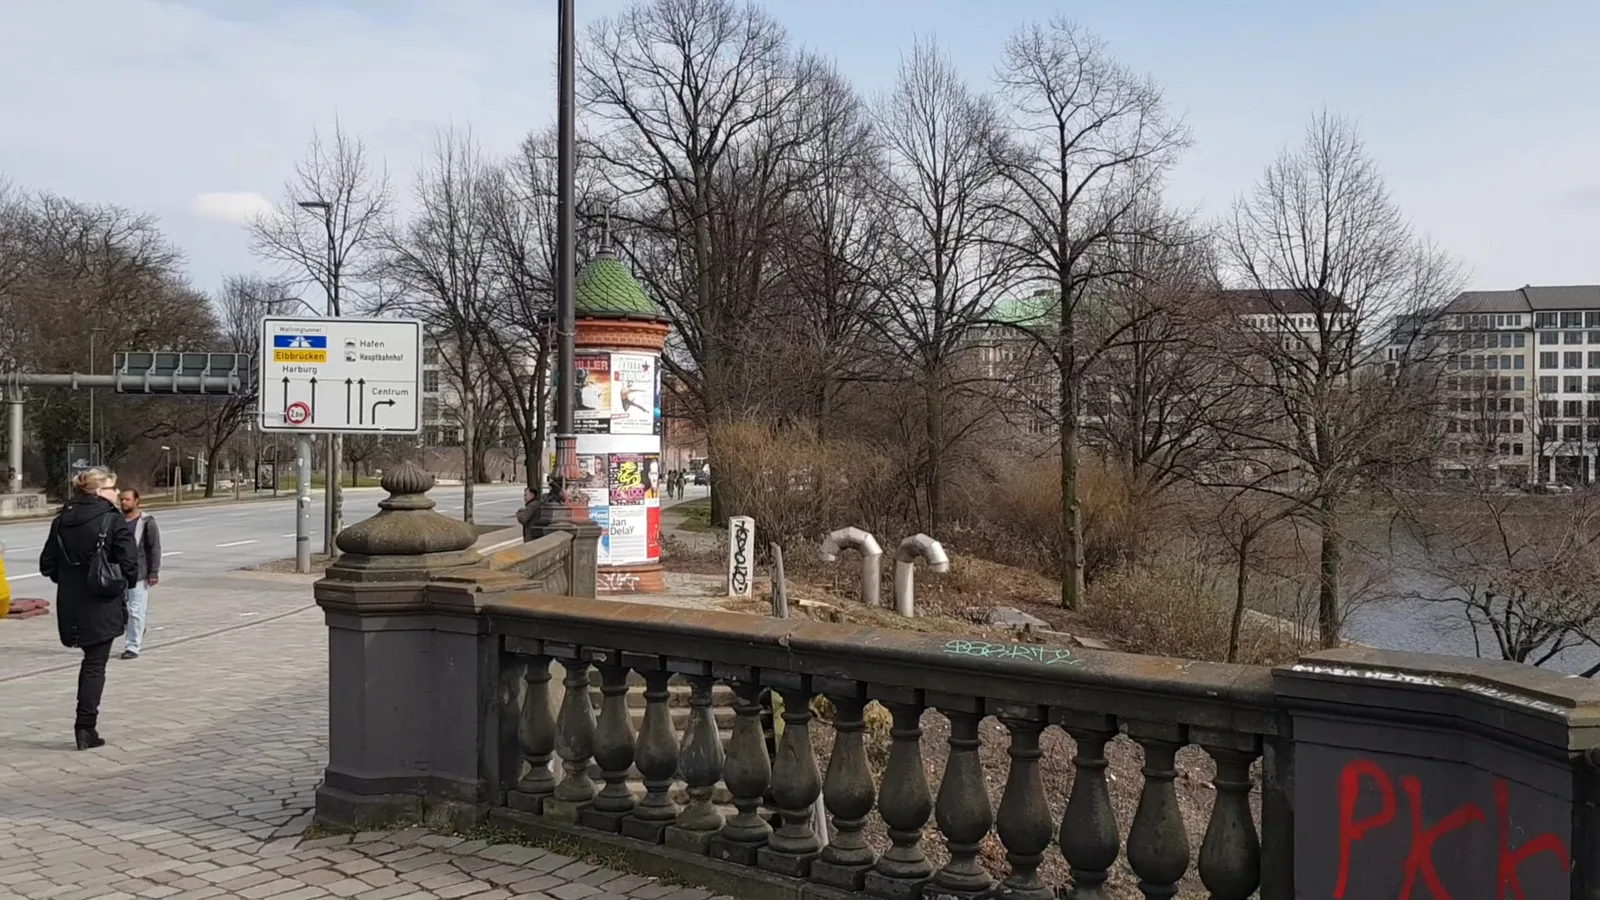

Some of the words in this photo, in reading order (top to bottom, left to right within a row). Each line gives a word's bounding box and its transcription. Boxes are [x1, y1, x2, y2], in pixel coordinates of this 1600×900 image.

[279, 326, 322, 334] Wallringtunnel
[359, 339, 385, 348] Hafen
[275, 350, 325, 361] Elbbrücken
[359, 353, 404, 363] Hauptbahnhof
[282, 365, 318, 375] Harburg
[371, 387, 409, 396] Centrum
[610, 518, 627, 527] Jan
